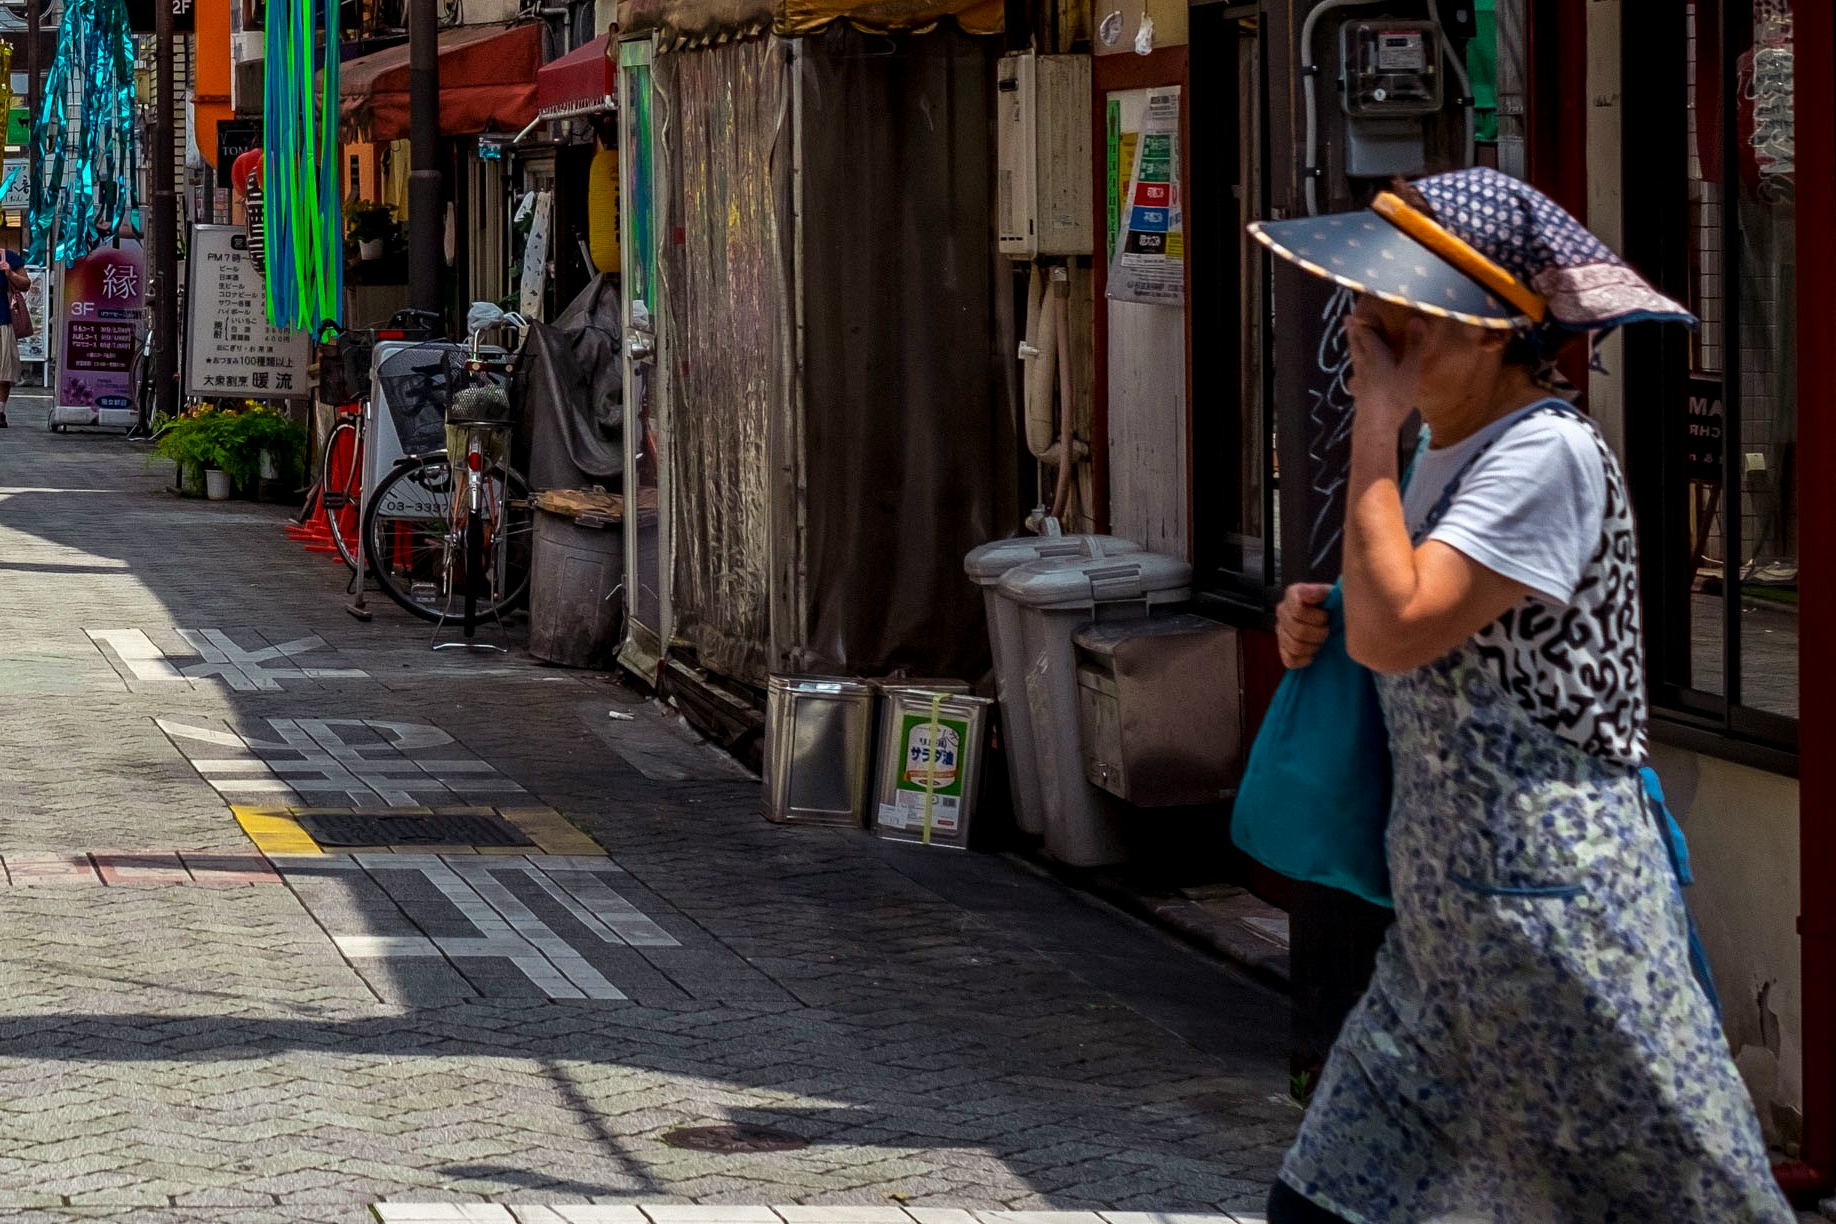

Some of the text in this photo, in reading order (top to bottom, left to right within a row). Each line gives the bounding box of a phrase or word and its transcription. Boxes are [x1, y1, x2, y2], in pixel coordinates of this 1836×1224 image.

[219, 265, 239, 273] ビール
[102, 263, 138, 300] 縁
[71, 301, 95, 316] 3F
[252, 371, 293, 390] 暖流
